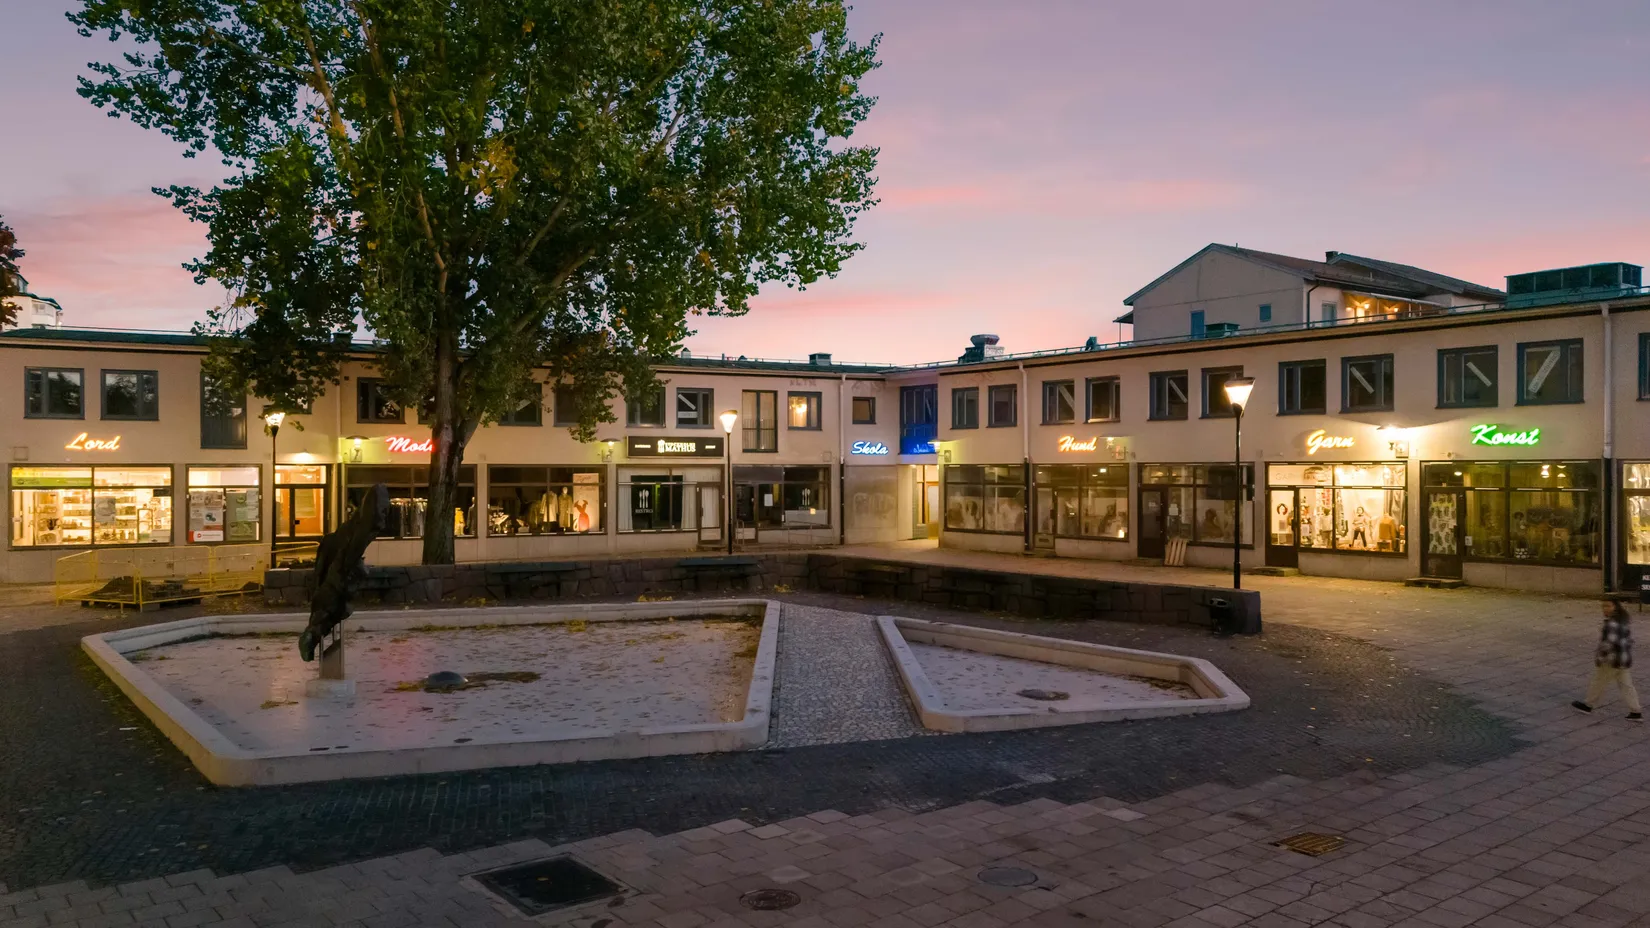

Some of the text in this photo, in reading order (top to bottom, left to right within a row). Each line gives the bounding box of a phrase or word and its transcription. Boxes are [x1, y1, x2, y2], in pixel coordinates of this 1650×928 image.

[64, 432, 121, 451] Lord
[1059, 435, 1098, 453] Hund
[1307, 429, 1356, 455] Garn
[1470, 424, 1540, 445] Konst
[851, 441, 889, 455] Skola
